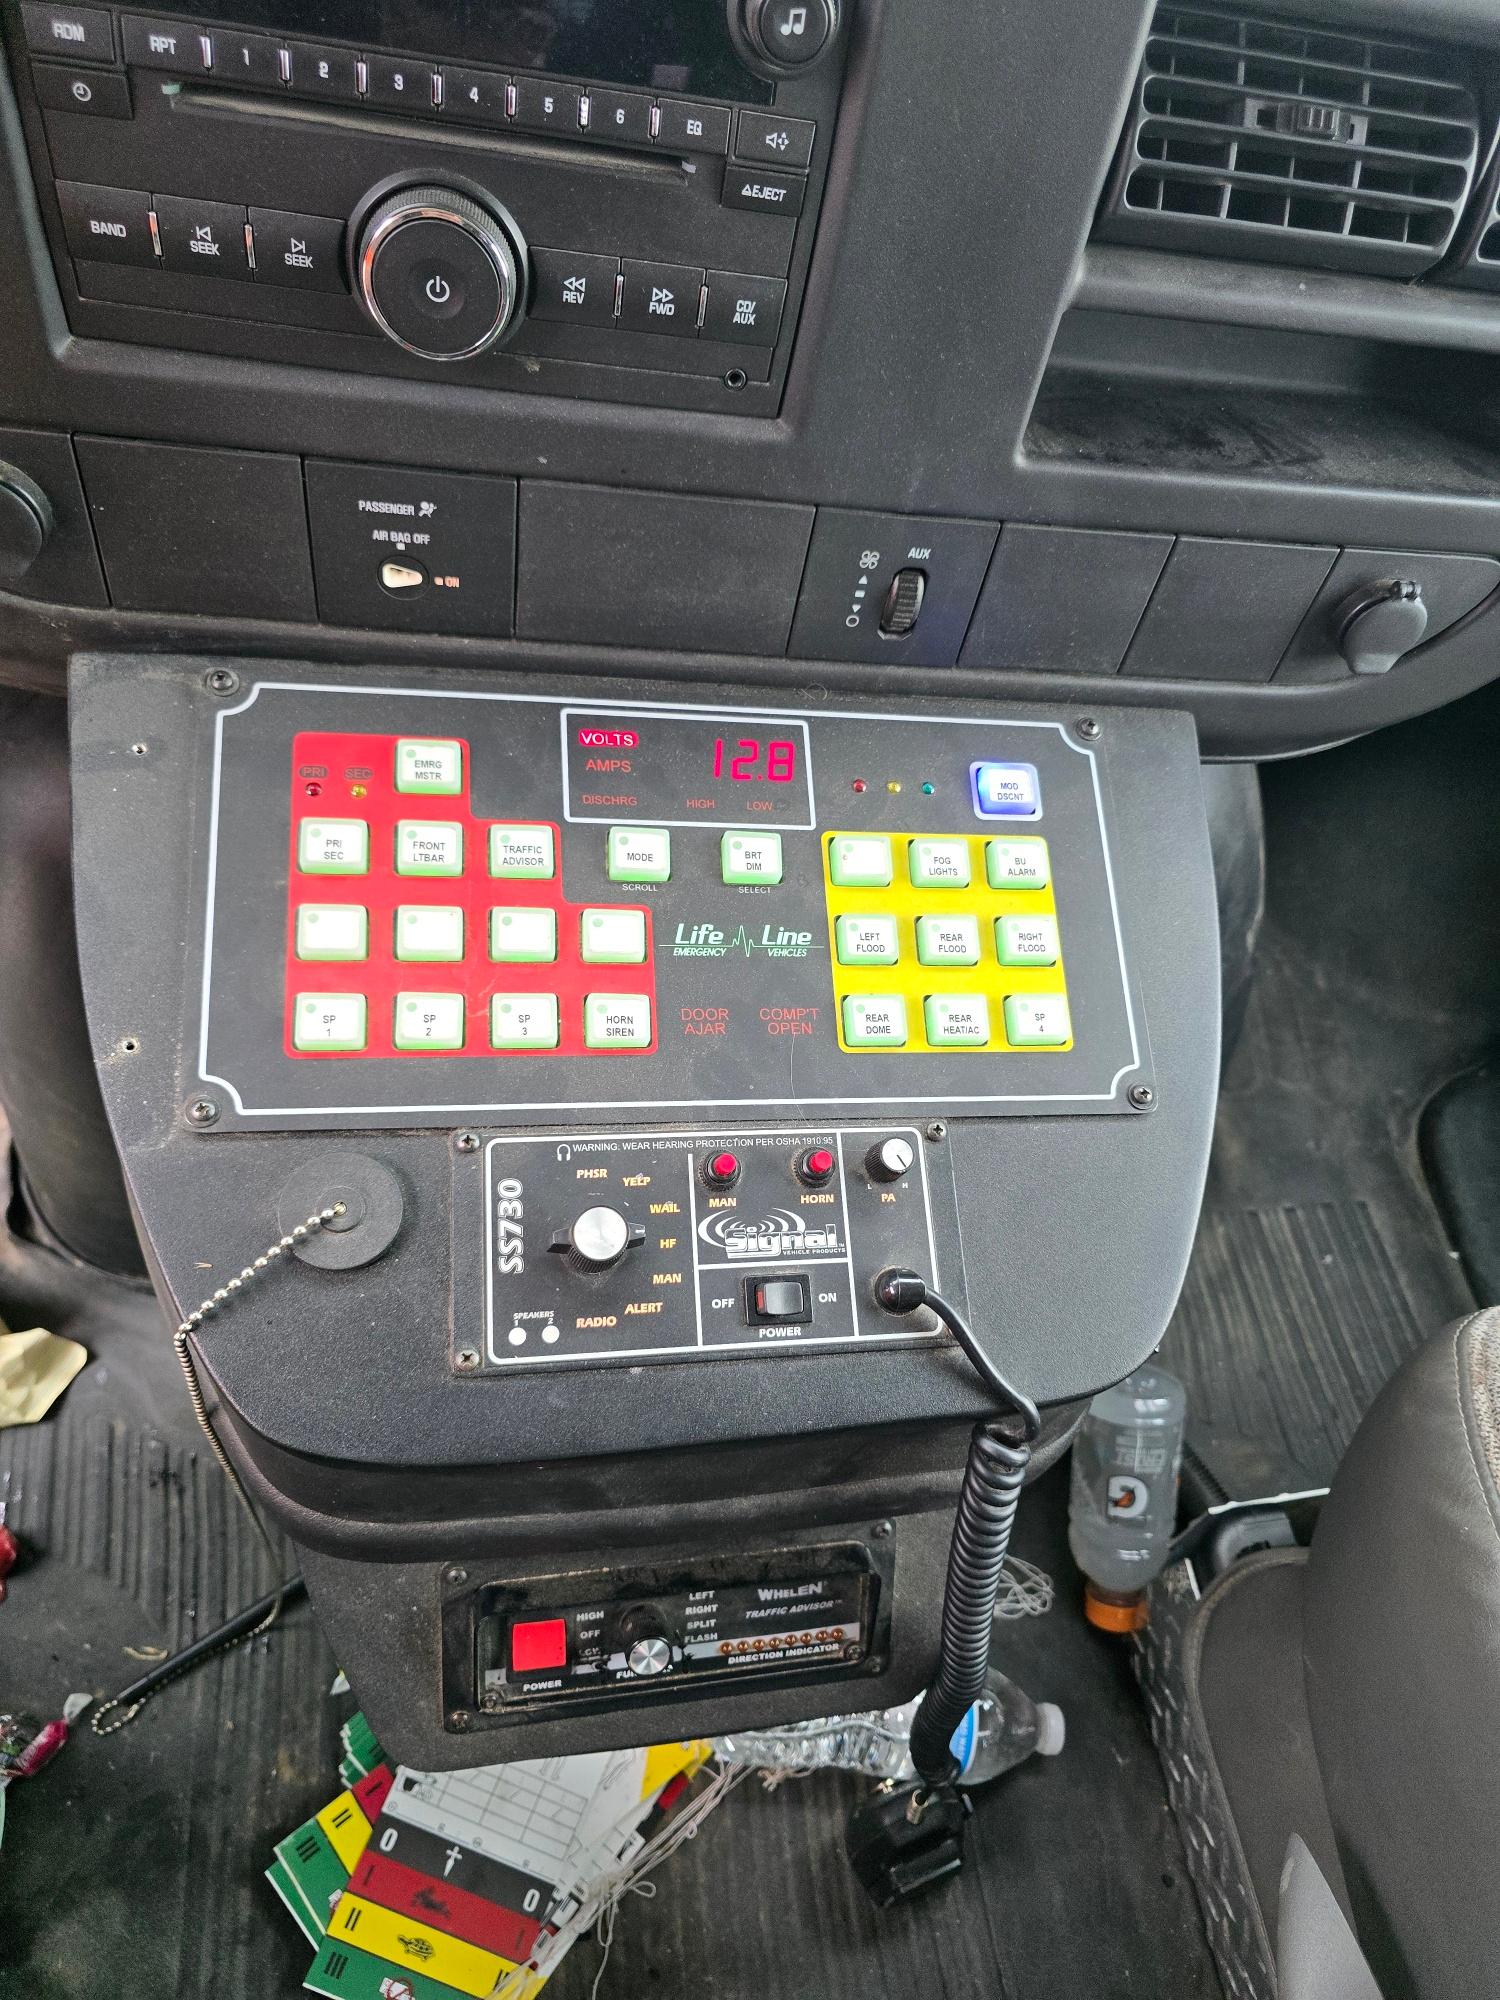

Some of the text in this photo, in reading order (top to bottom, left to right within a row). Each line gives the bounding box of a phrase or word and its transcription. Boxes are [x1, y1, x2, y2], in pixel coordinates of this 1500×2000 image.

[52, 21, 85, 42] RDM
[149, 35, 177, 55] RPT
[242, 49, 250, 66] 1
[319, 61, 329, 79] 2
[394, 74, 404, 91] 3
[469, 86, 479, 103] 4
[544, 97, 554, 114] 5
[616, 108, 625, 124] 6
[687, 119, 703, 137] EQ
[752, 186, 787, 203] EJECT
[90, 220, 127, 238] BAND
[190, 240, 220, 256] SEEK
[284, 252, 313, 269] SEEK
[563, 290, 585, 305] REV
[649, 301, 675, 316] FWD
[733, 311, 756, 325] AUX
[358, 500, 415, 516] PASSENGER
[373, 529, 431, 545] AIR BAG OFF
[907, 546, 931, 560] AUX
[581, 732, 634, 746] VOLTS
[414, 759, 443, 770] EMRG
[586, 759, 632, 773] AMPS
[713, 739, 795, 783] 12.8
[303, 767, 325, 778] PRI
[346, 768, 372, 779] SEC
[415, 771, 442, 781] MSTR
[1000, 782, 1019, 791] MOD
[583, 794, 638, 807] DISCHRG
[997, 792, 1024, 801] DSCNT
[686, 798, 716, 810] HIGH
[747, 799, 773, 811] LOW
[325, 838, 343, 849] PRI
[412, 840, 445, 852] FRONT
[323, 850, 344, 860] SEC
[503, 844, 542, 855] TRAFFIC
[744, 850, 762, 860] BRT
[412, 852, 445, 863] LTBAR
[502, 856, 545, 867] ADVISOR
[627, 852, 654, 863] MODE
[933, 857, 951, 865] FOG
[1015, 857, 1026, 866] BU
[746, 862, 762, 872] DIM
[929, 867, 958, 877] LIGHTS
[1007, 868, 1037, 877] ALARM
[622, 882, 658, 892] SCROLL
[738, 885, 772, 894] SELECT
[675, 923, 813, 947] Life Line
[860, 932, 880, 941] LEFT
[940, 933, 963, 942] REAR
[1018, 932, 1043, 942] RIGHT
[673, 947, 808, 958] EMERGENCY VEHICLES
[856, 944, 885, 953] FLOOD
[938, 944, 967, 953] FLOOD
[1018, 944, 1046, 953] FLOOD
[322, 1014, 337, 1025] SP
[423, 1013, 437, 1024] SP
[518, 1014, 531, 1024] SP
[681, 1007, 729, 1021] DOOR
[759, 1007, 820, 1021] COMP'T
[865, 1014, 889, 1023] REAR
[949, 1014, 972, 1023] REAR
[1035, 1013, 1046, 1022] SP
[606, 1015, 634, 1025] HORN
[425, 1026, 432, 1037] 2
[521, 1026, 528, 1036] 3
[605, 1027, 635, 1037] SIREN
[684, 1022, 726, 1036] AJAR
[768, 1021, 813, 1036] OPEN
[866, 1025, 891, 1034] DOME
[1039, 1025, 1044, 1033] 4
[622, 1141, 650, 1150] WEAR
[652, 1139, 695, 1149] HEARING
[696, 1137, 754, 1148] PROTECTION
[755, 1138, 775, 1146] PER
[776, 1137, 801, 1146] OSHA
[802, 1136, 834, 1146] 1910.95
[576, 1168, 608, 1179] PHSR
[623, 1176, 651, 1187] YELP
[709, 1198, 737, 1208] MAN
[801, 1194, 834, 1204] HORN
[881, 1193, 896, 1202] PA
[650, 1203, 680, 1214] WAIL
[498, 1178, 524, 1274] SS730
[660, 1239, 677, 1248] HF
[653, 1273, 682, 1284] MAN
[711, 1298, 735, 1309] OFF
[818, 1293, 837, 1303] ON
[624, 1302, 663, 1314] ALERT
[513, 1310, 555, 1320] SPEAKERS
[576, 1316, 617, 1328] RADIO
[759, 1327, 802, 1338] POWER
[689, 1590, 715, 1601] LEFT
[685, 1604, 719, 1616] RIGHT
[744, 1606, 787, 1619] TRAFFIC
[576, 1610, 605, 1622] HIGH
[686, 1619, 717, 1630] SPLIT
[580, 1629, 601, 1640] OFF
[684, 1632, 718, 1644] FLASH
[728, 1643, 840, 1664] DIRECTION INDICATOR
[522, 1679, 562, 1692] POWER
[379, 1828, 398, 1852] 0
[522, 1888, 541, 1912] 0
